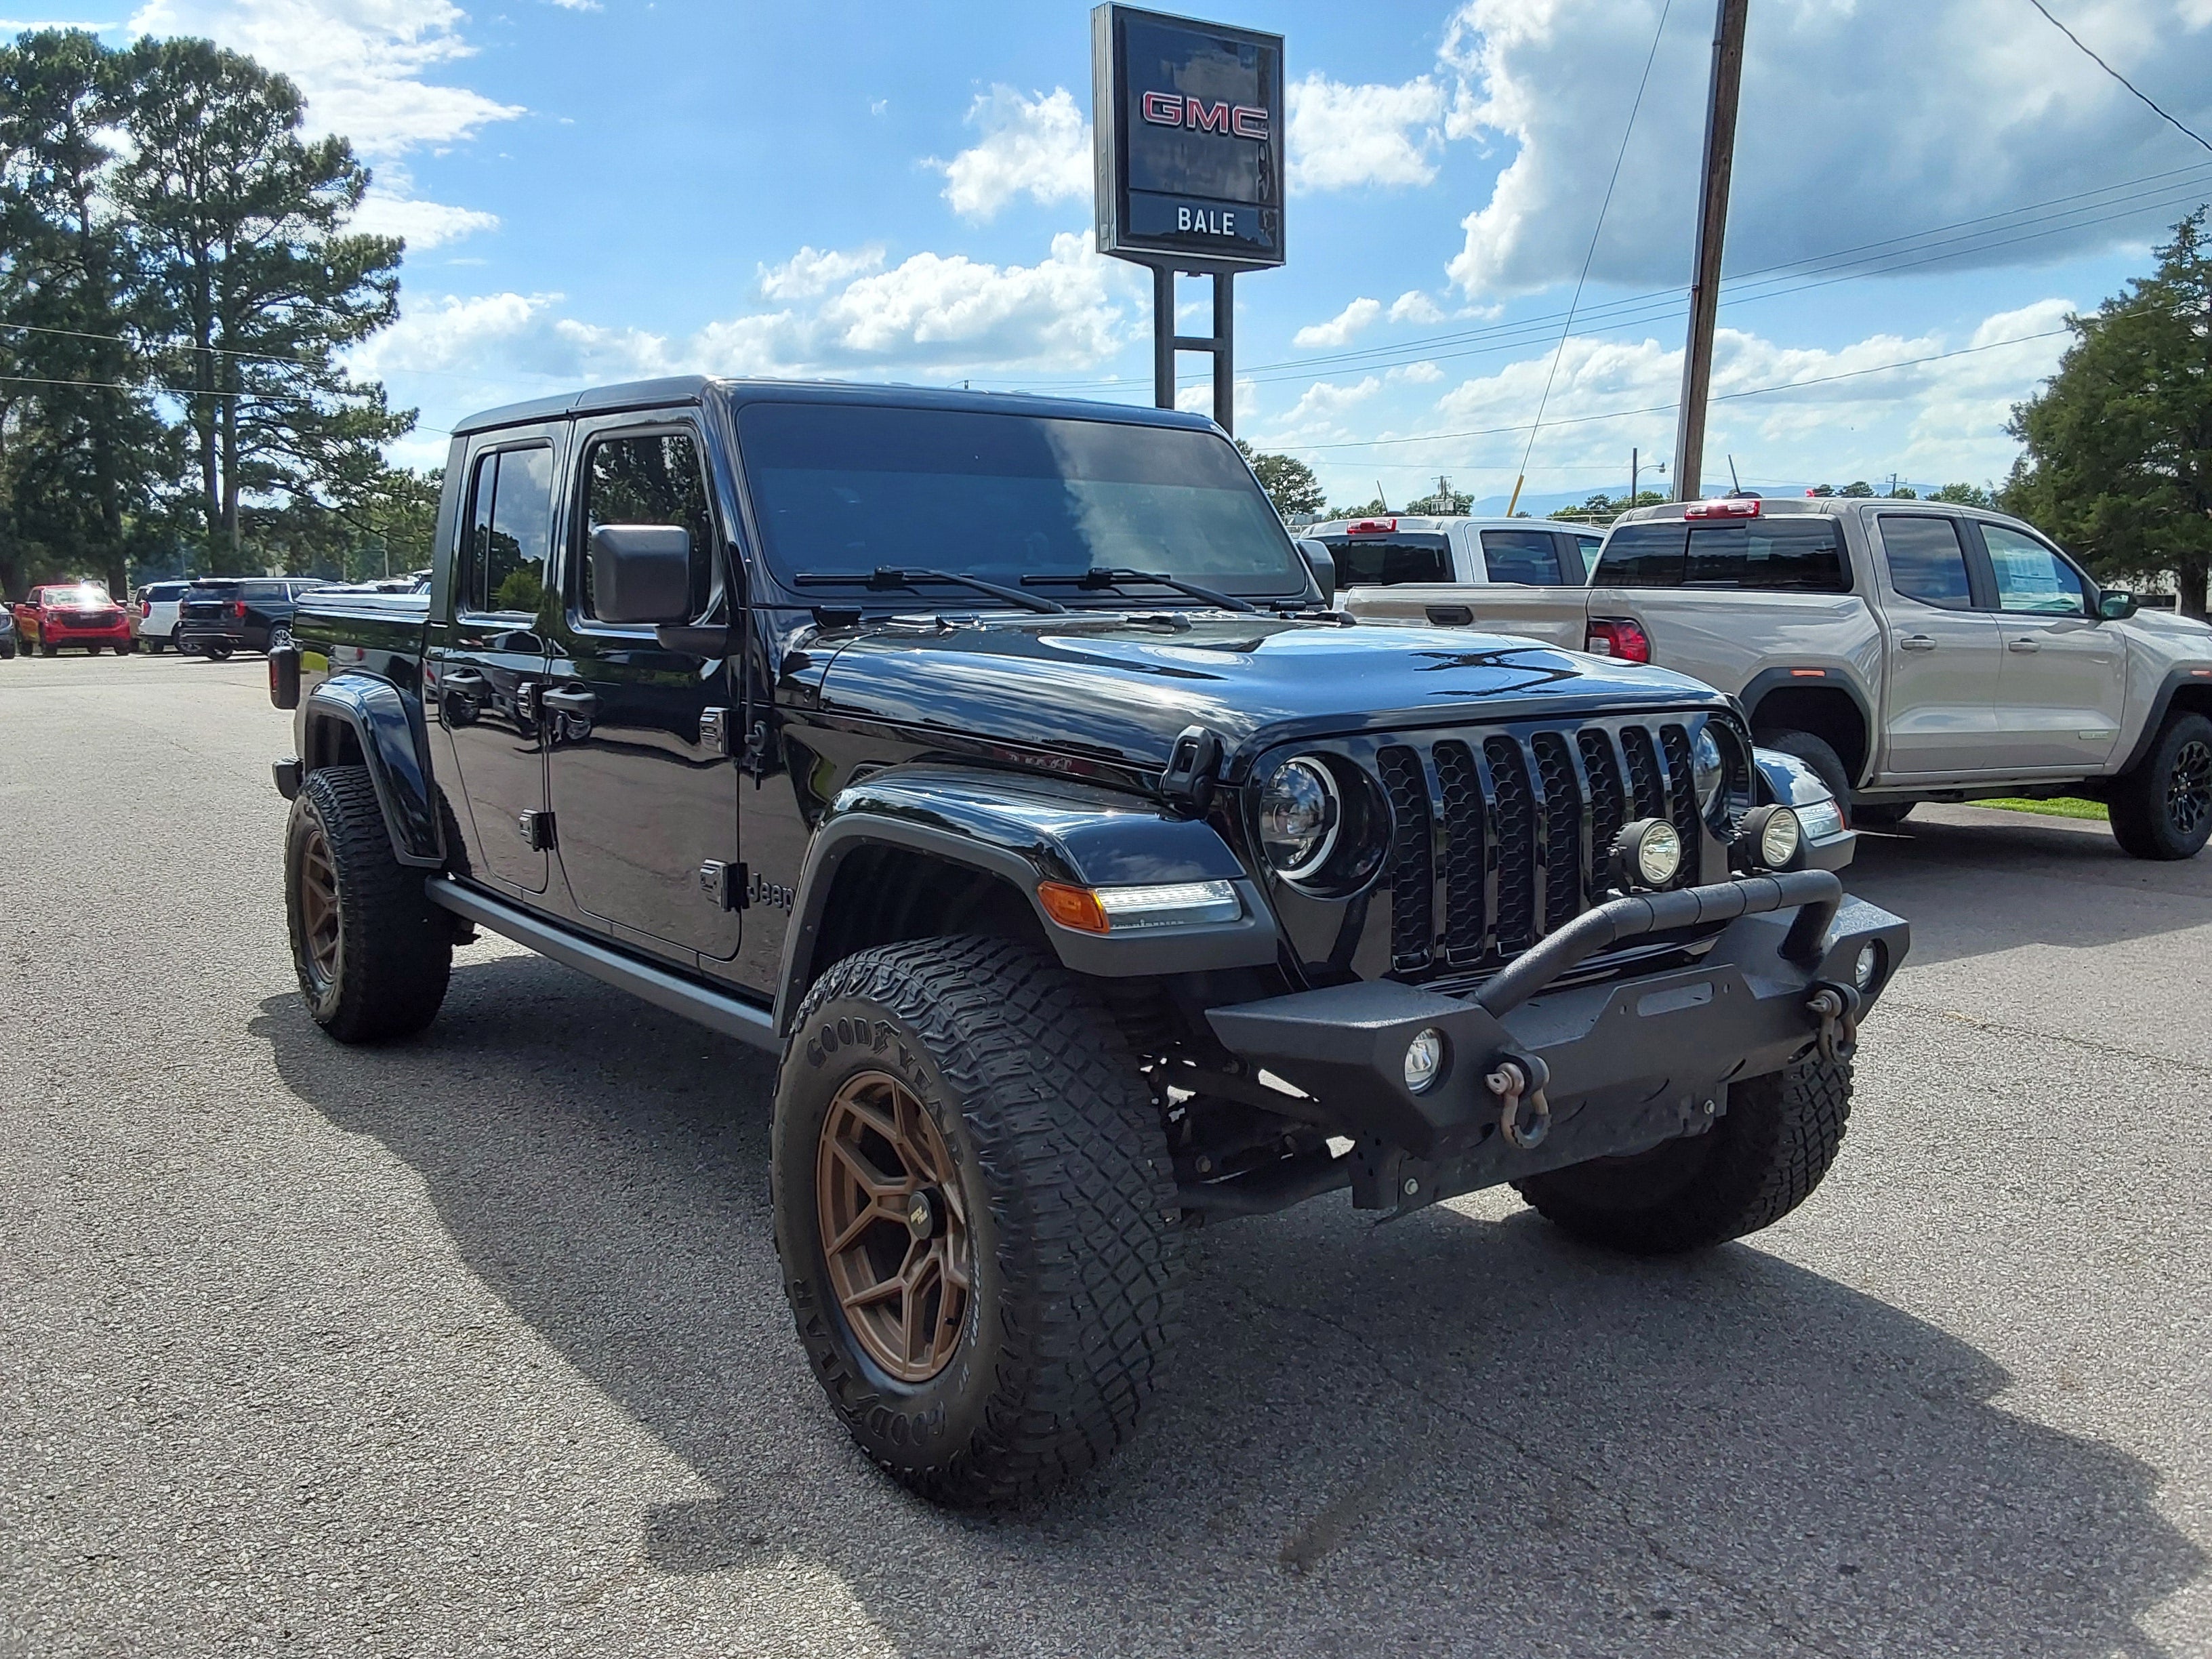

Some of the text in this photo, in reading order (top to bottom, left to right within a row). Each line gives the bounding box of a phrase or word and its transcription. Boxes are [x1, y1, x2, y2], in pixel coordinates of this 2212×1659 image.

[1143, 90, 1268, 140] GMC
[1178, 206, 1235, 237] BALE
[747, 872, 796, 918] Jeep
[806, 1016, 964, 1166] GOODYEAR
